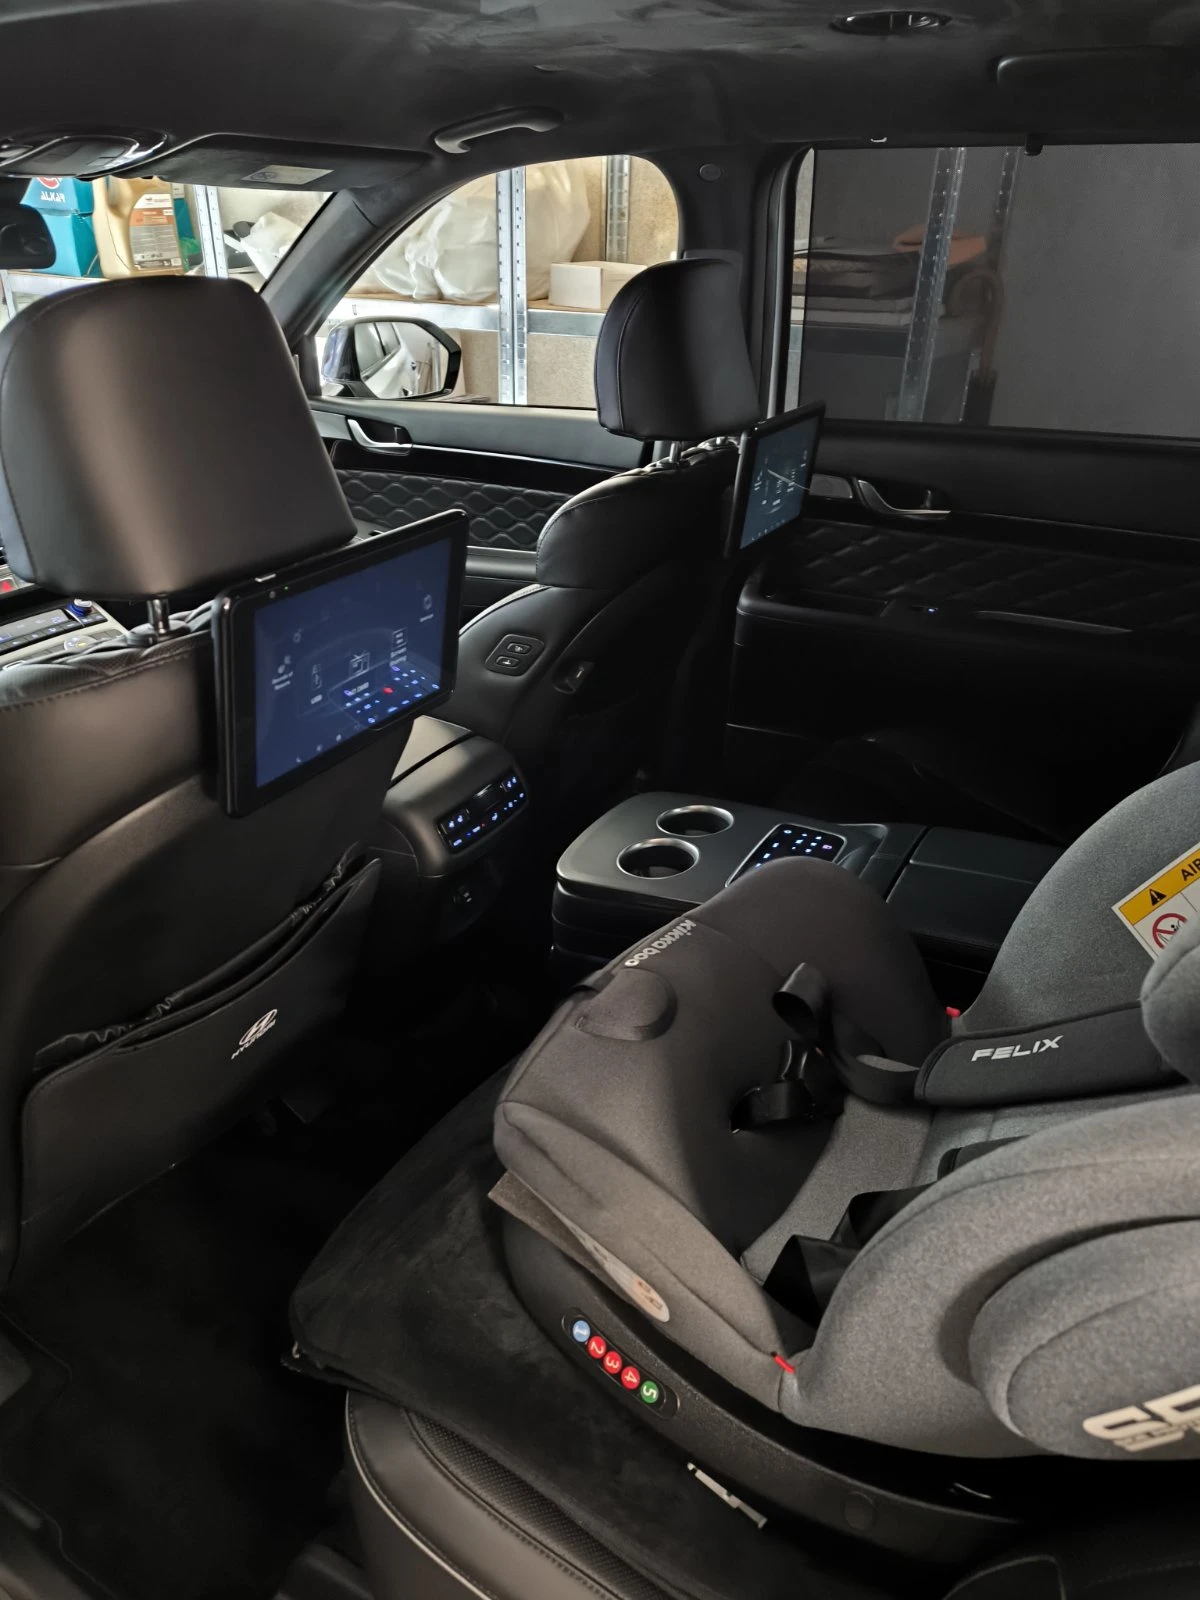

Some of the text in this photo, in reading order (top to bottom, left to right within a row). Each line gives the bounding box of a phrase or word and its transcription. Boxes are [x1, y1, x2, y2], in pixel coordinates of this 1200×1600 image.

[971, 1034, 1064, 1062] FELIX
[590, 1340, 605, 1355] 2
[605, 1356, 620, 1369] 3
[624, 1370, 638, 1384] 4
[642, 1385, 657, 1399] 5
